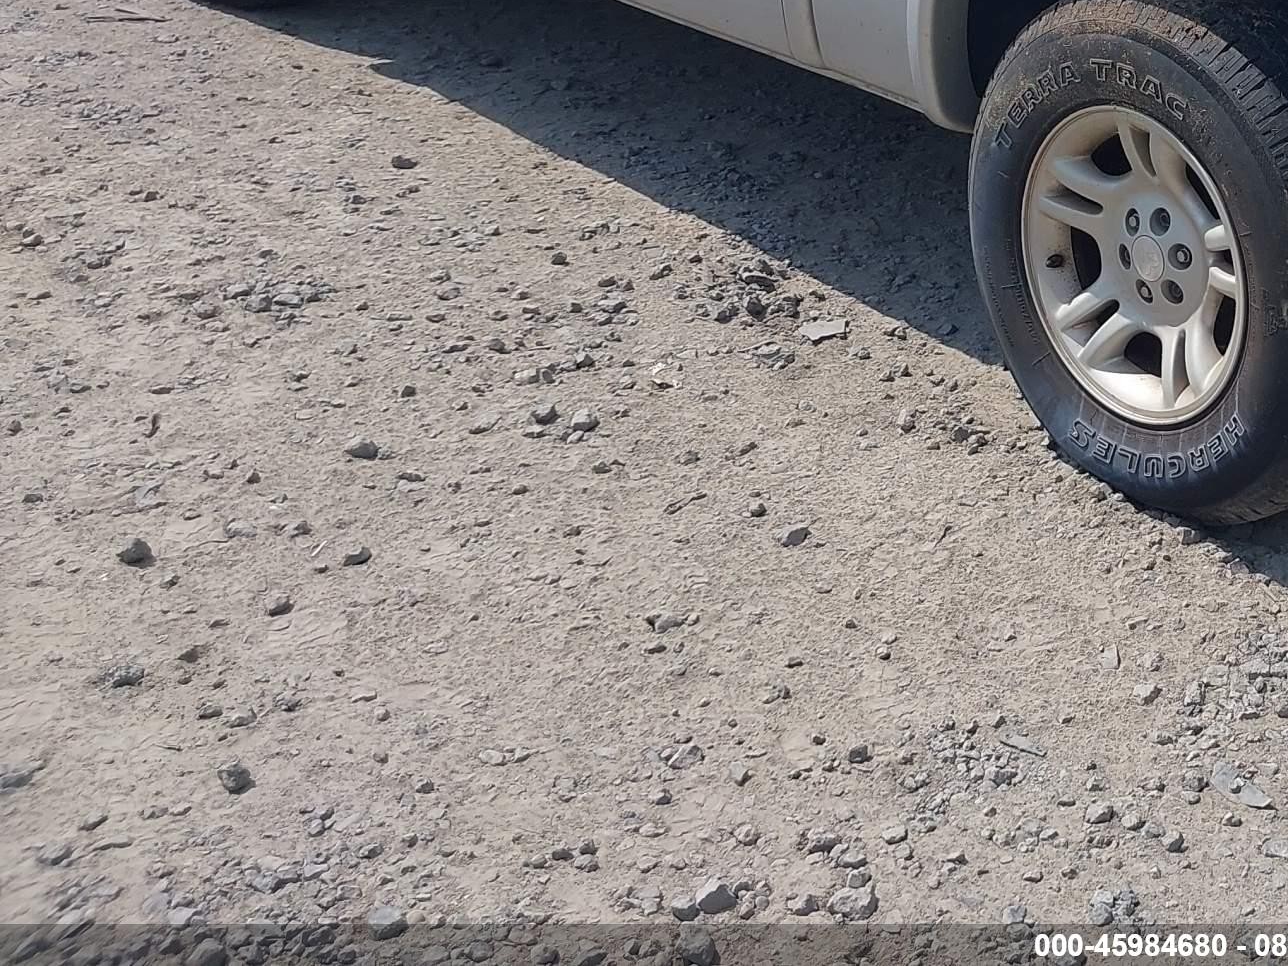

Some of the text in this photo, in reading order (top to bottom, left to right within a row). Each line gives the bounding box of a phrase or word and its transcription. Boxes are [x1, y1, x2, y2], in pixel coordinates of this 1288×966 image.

[992, 58, 1188, 148] TERRA TRAC
[1067, 412, 1246, 479] HERCULES
